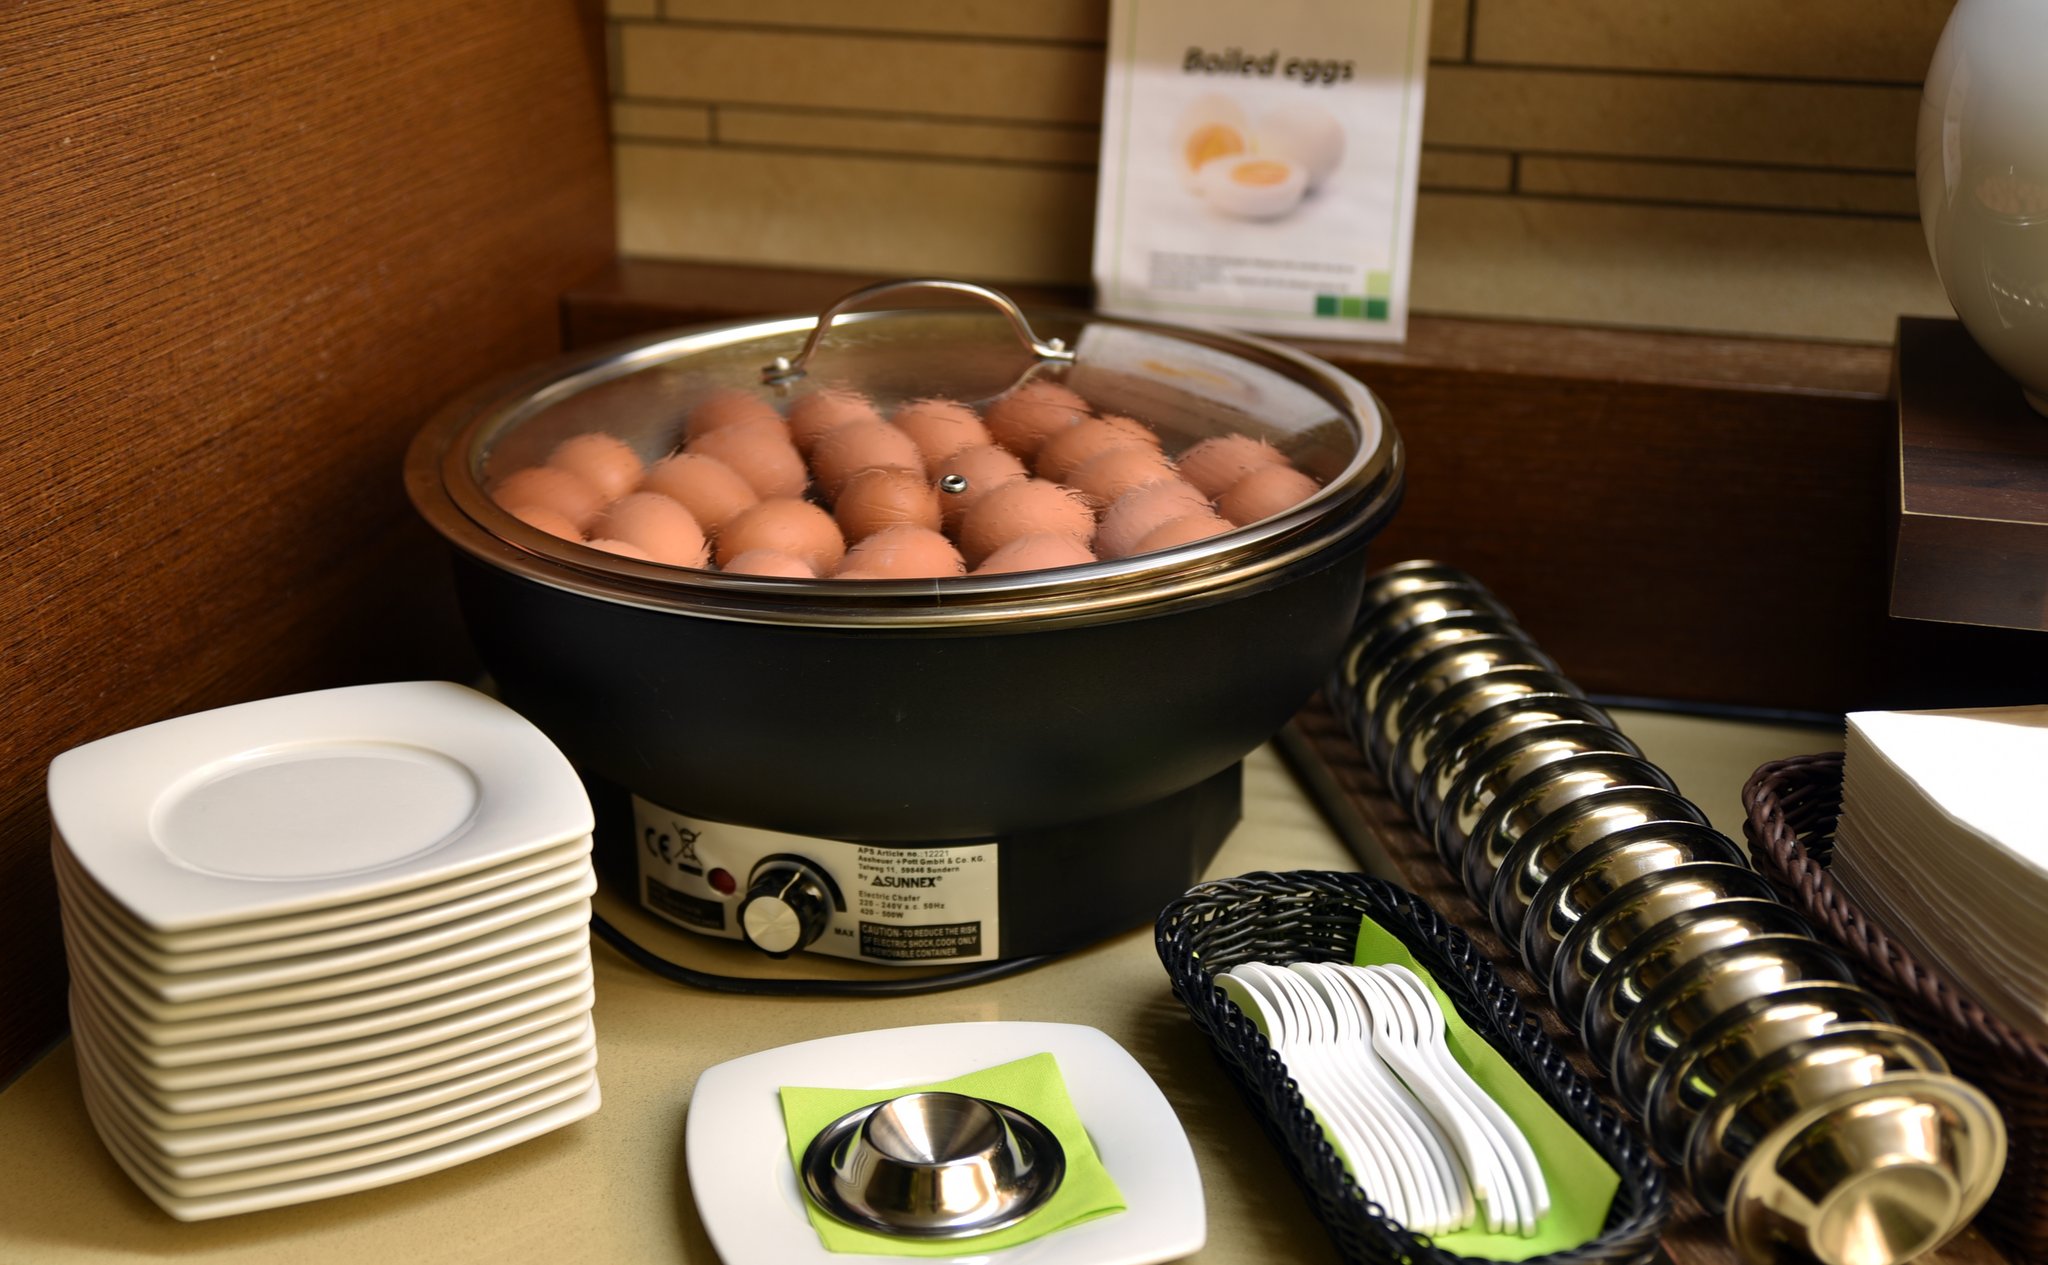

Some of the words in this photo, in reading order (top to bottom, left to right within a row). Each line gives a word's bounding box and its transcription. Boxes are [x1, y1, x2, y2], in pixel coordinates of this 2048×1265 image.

[1183, 46, 1279, 78] Boiled
[1283, 57, 1356, 87] eggs
[858, 847, 874, 855] APS
[877, 849, 904, 857] Article
[858, 890, 890, 901] Electric
[892, 894, 920, 902] Chafer
[834, 928, 854, 938] MAX
[914, 928, 944, 937] REDUCE
[945, 927, 959, 936] THE
[960, 925, 977, 934] RISK
[873, 938, 907, 948] ELECTRIC
[958, 936, 977, 946] ONLY
